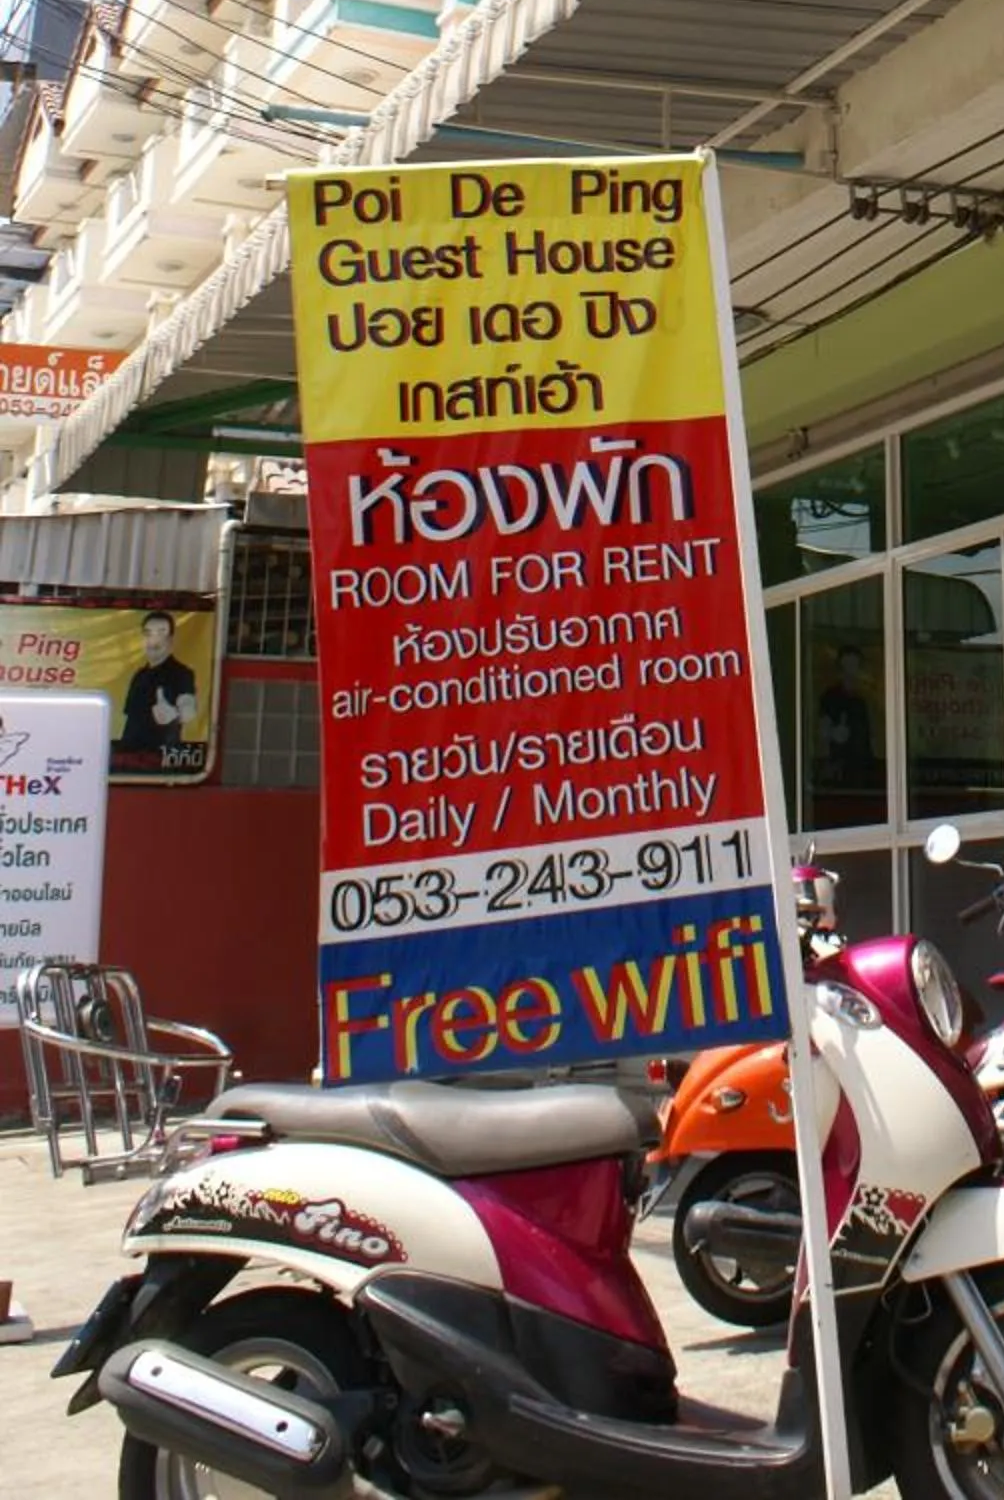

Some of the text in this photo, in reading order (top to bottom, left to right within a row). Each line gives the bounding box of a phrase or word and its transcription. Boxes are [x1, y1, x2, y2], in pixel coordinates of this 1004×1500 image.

[313, 169, 684, 226] Poi De Ping
[319, 230, 675, 286] Guest House
[327, 291, 658, 353] ปอย เดอ ปิง
[399, 359, 606, 422] เกสท์เฮ้า
[348, 437, 691, 547] ห้องพัก
[330, 538, 722, 610] ROOM FOR RENT
[18, 633, 81, 662] Ping
[392, 605, 682, 668] ห้องปรับอากาศ
[332, 648, 742, 720] air-conditioned room
[360, 713, 705, 791] รายวัน/รายเดือน
[362, 767, 717, 849] Daily / Monthly
[331, 829, 753, 933] 053-243-911
[325, 913, 774, 1082] Free wifi
[294, 1201, 390, 1259] Fino
